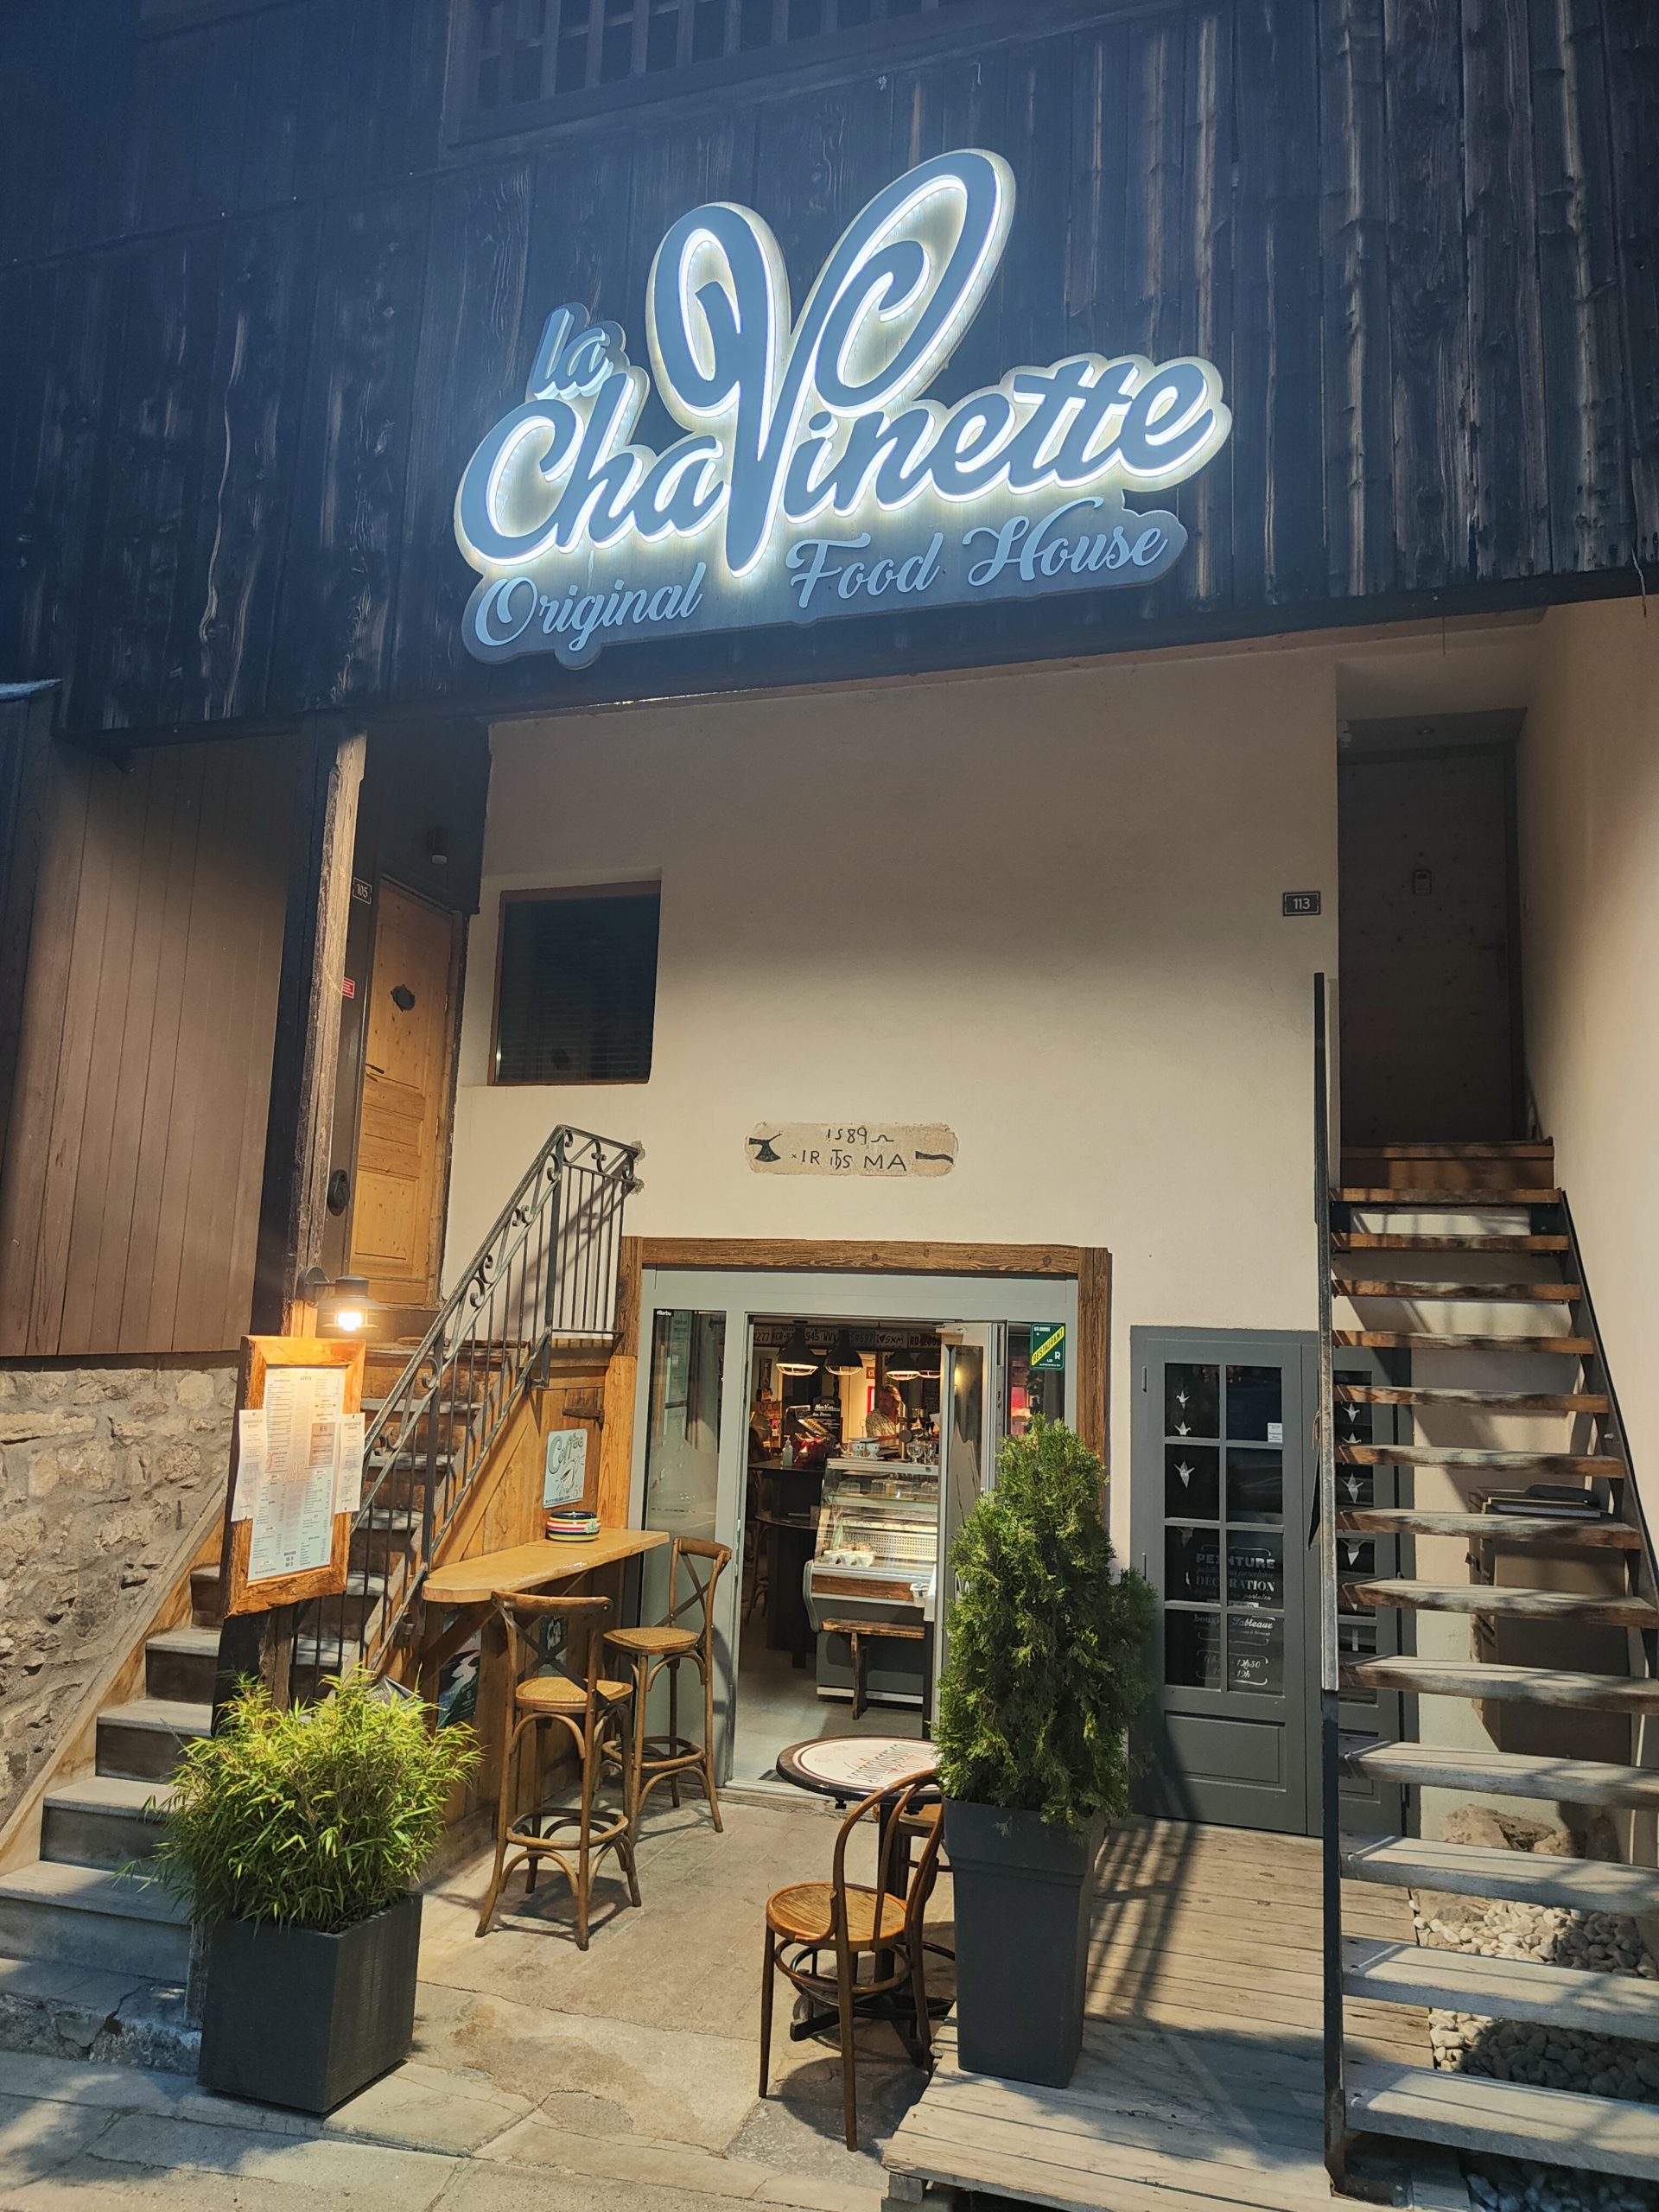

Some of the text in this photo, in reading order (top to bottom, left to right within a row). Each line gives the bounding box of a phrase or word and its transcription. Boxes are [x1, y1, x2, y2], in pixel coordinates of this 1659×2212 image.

[475, 496, 1168, 652] Original Food House
[356, 883, 368, 899] 105
[1293, 898, 1311, 910] 113
[1033, 1330, 1063, 1363] RESTAURANT
[1054, 1351, 1061, 1360] R
[548, 1432, 584, 1475] Coffee
[1197, 1574, 1275, 1592] DÉCRATION
